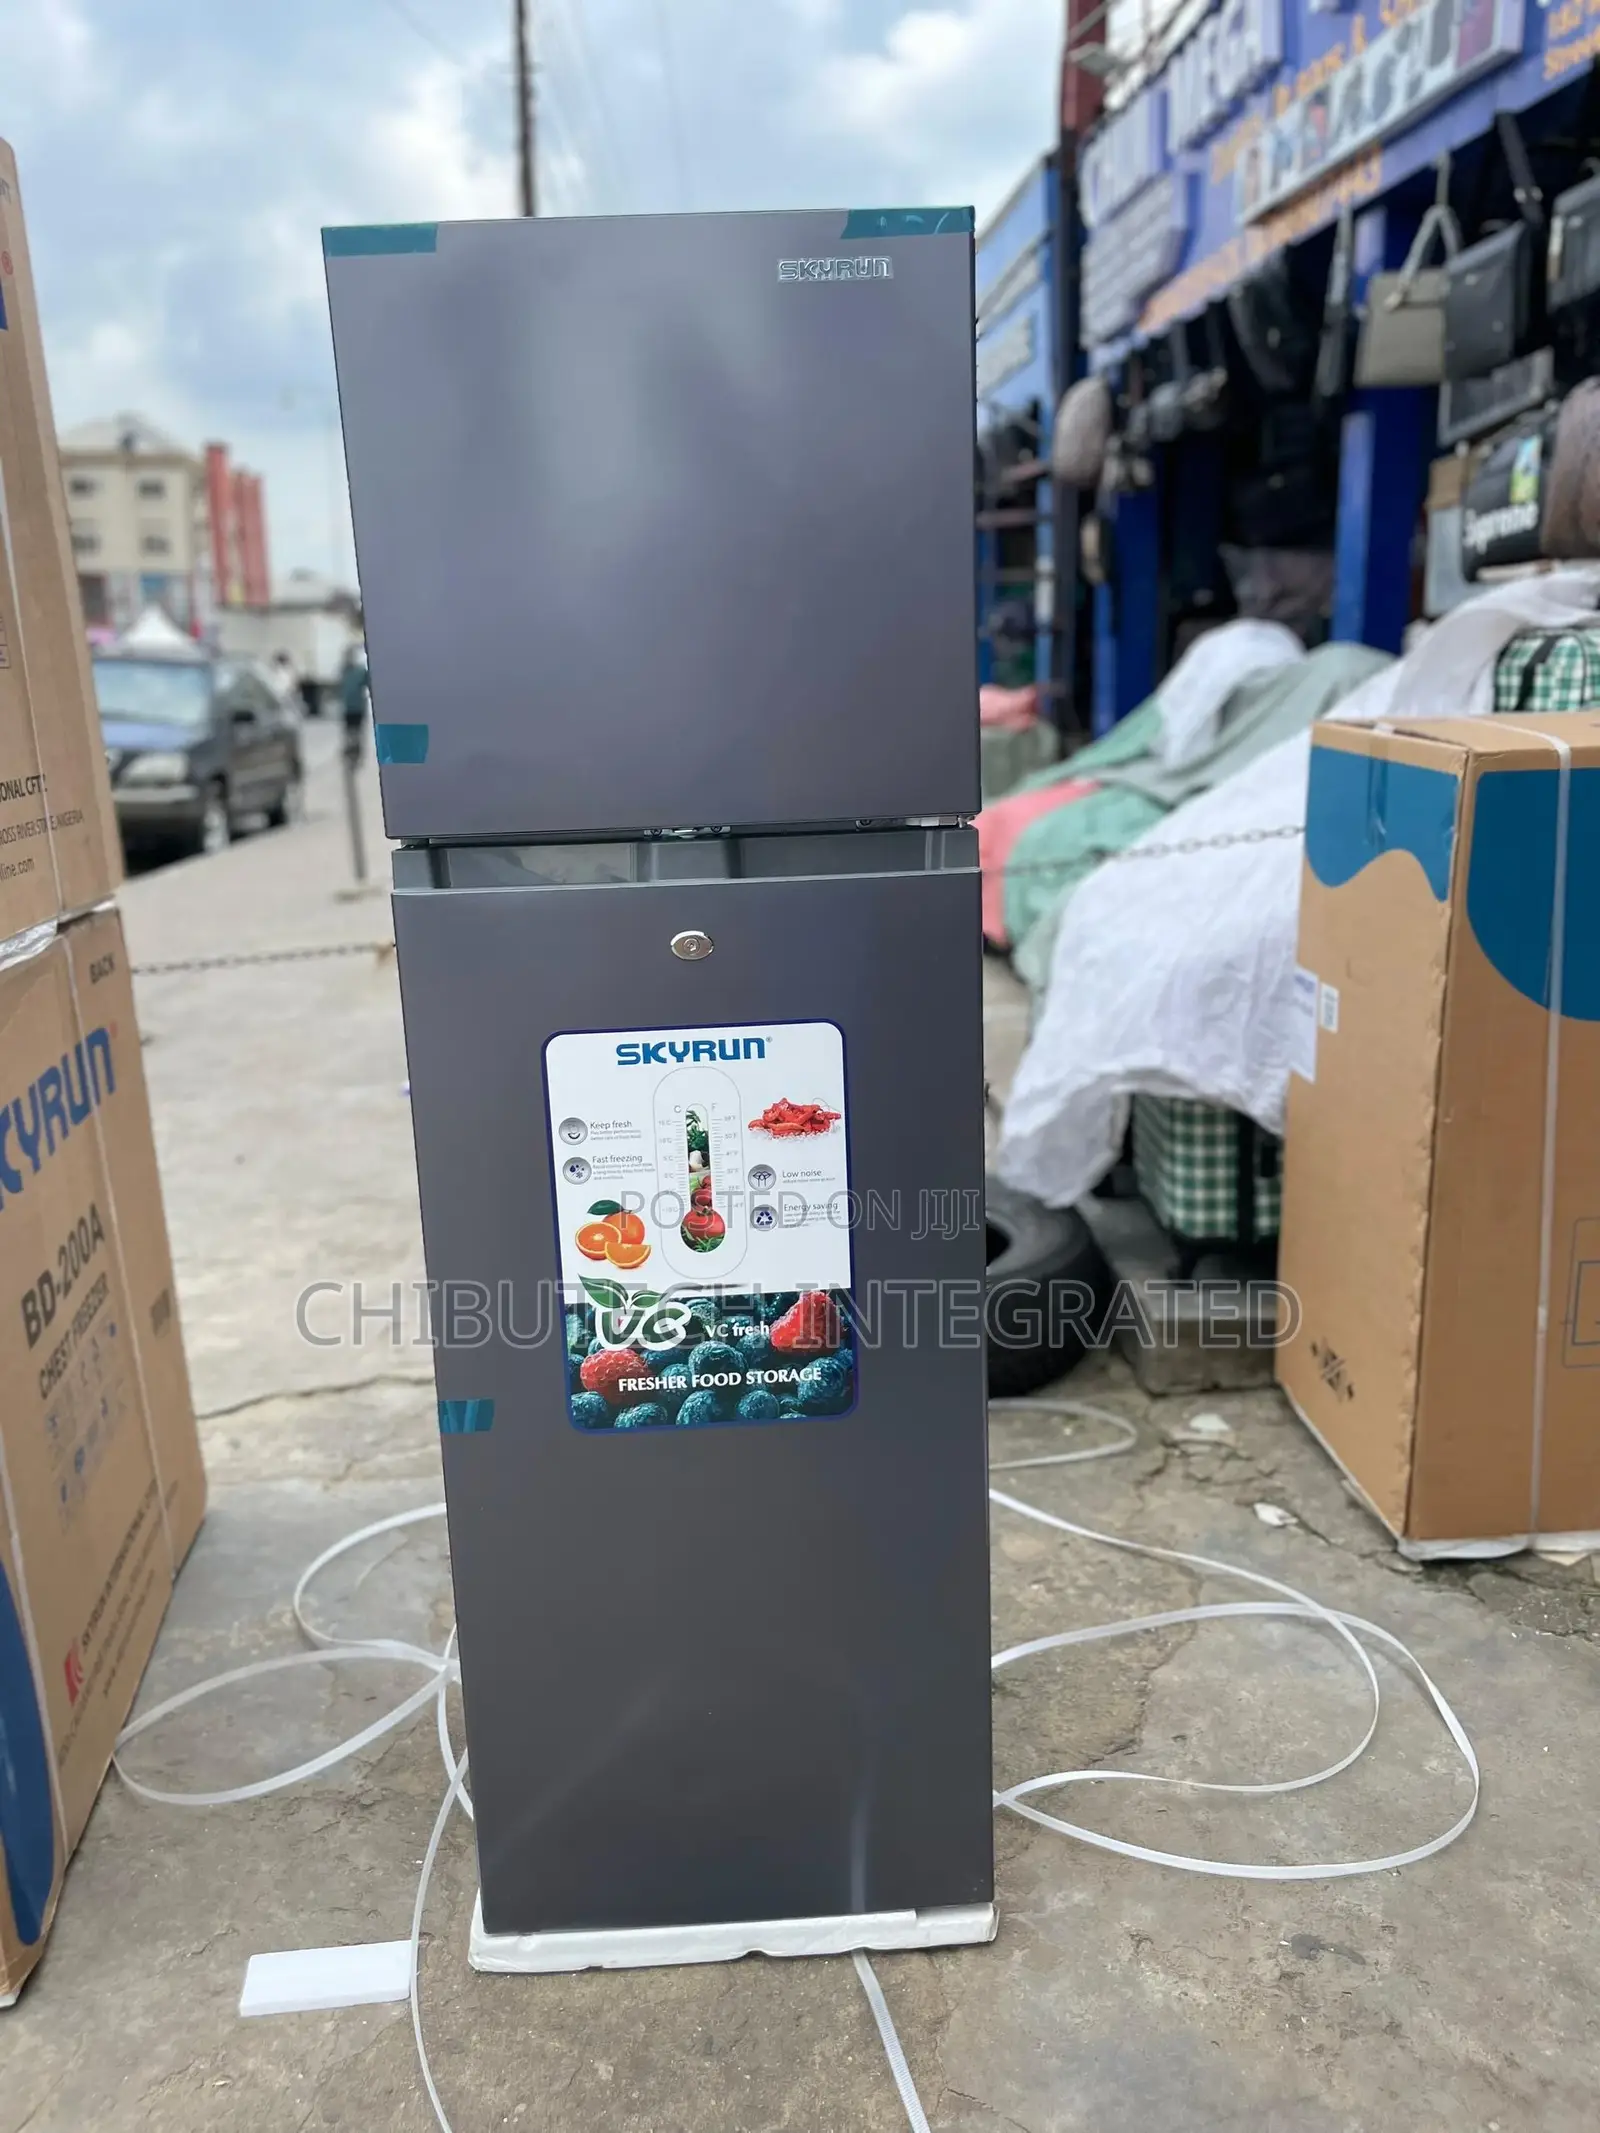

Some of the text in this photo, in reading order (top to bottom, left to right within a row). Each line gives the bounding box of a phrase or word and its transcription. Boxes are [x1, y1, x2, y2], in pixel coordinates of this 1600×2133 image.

[779, 257, 892, 281] SKYRUN
[0, 778, 26, 802] ONAL
[90, 953, 115, 985] BACK
[615, 1037, 766, 1066] SKYRUN
[590, 1120, 632, 1129] Keep fresh
[610, 1155, 643, 1163] freezing
[782, 1170, 799, 1178] Low
[784, 1202, 838, 1213] Energy saving
[21, 1203, 104, 1350] BD-200A
[705, 1321, 770, 1338] VC fresh
[618, 1367, 822, 1392] FRESHER FOOD STORAGE
